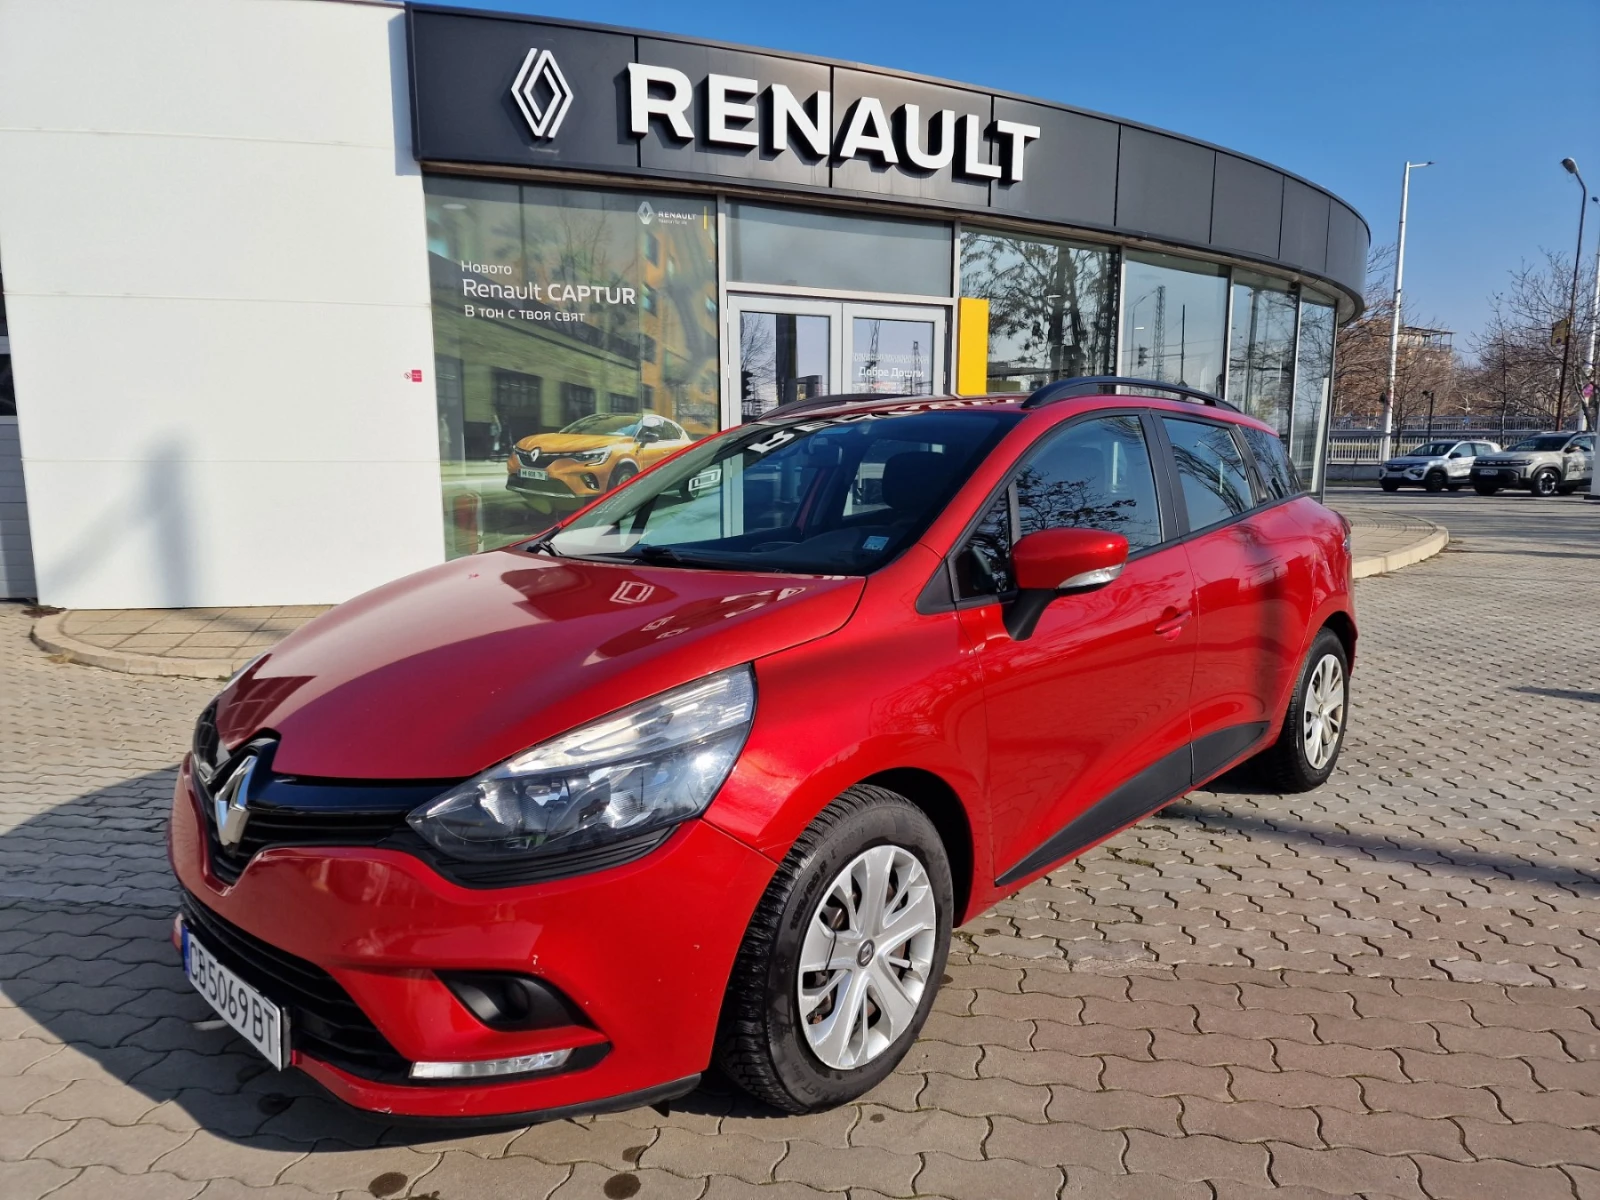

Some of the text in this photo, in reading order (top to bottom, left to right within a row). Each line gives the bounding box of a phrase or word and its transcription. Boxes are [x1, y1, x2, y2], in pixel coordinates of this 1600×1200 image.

[627, 62, 1041, 183] RENAULT
[658, 210, 697, 220] RENAULT
[461, 260, 513, 275] Новото
[462, 278, 636, 305] Renault CAPTUR
[464, 304, 586, 322] В тон с твоя свят
[859, 366, 889, 378] Добре
